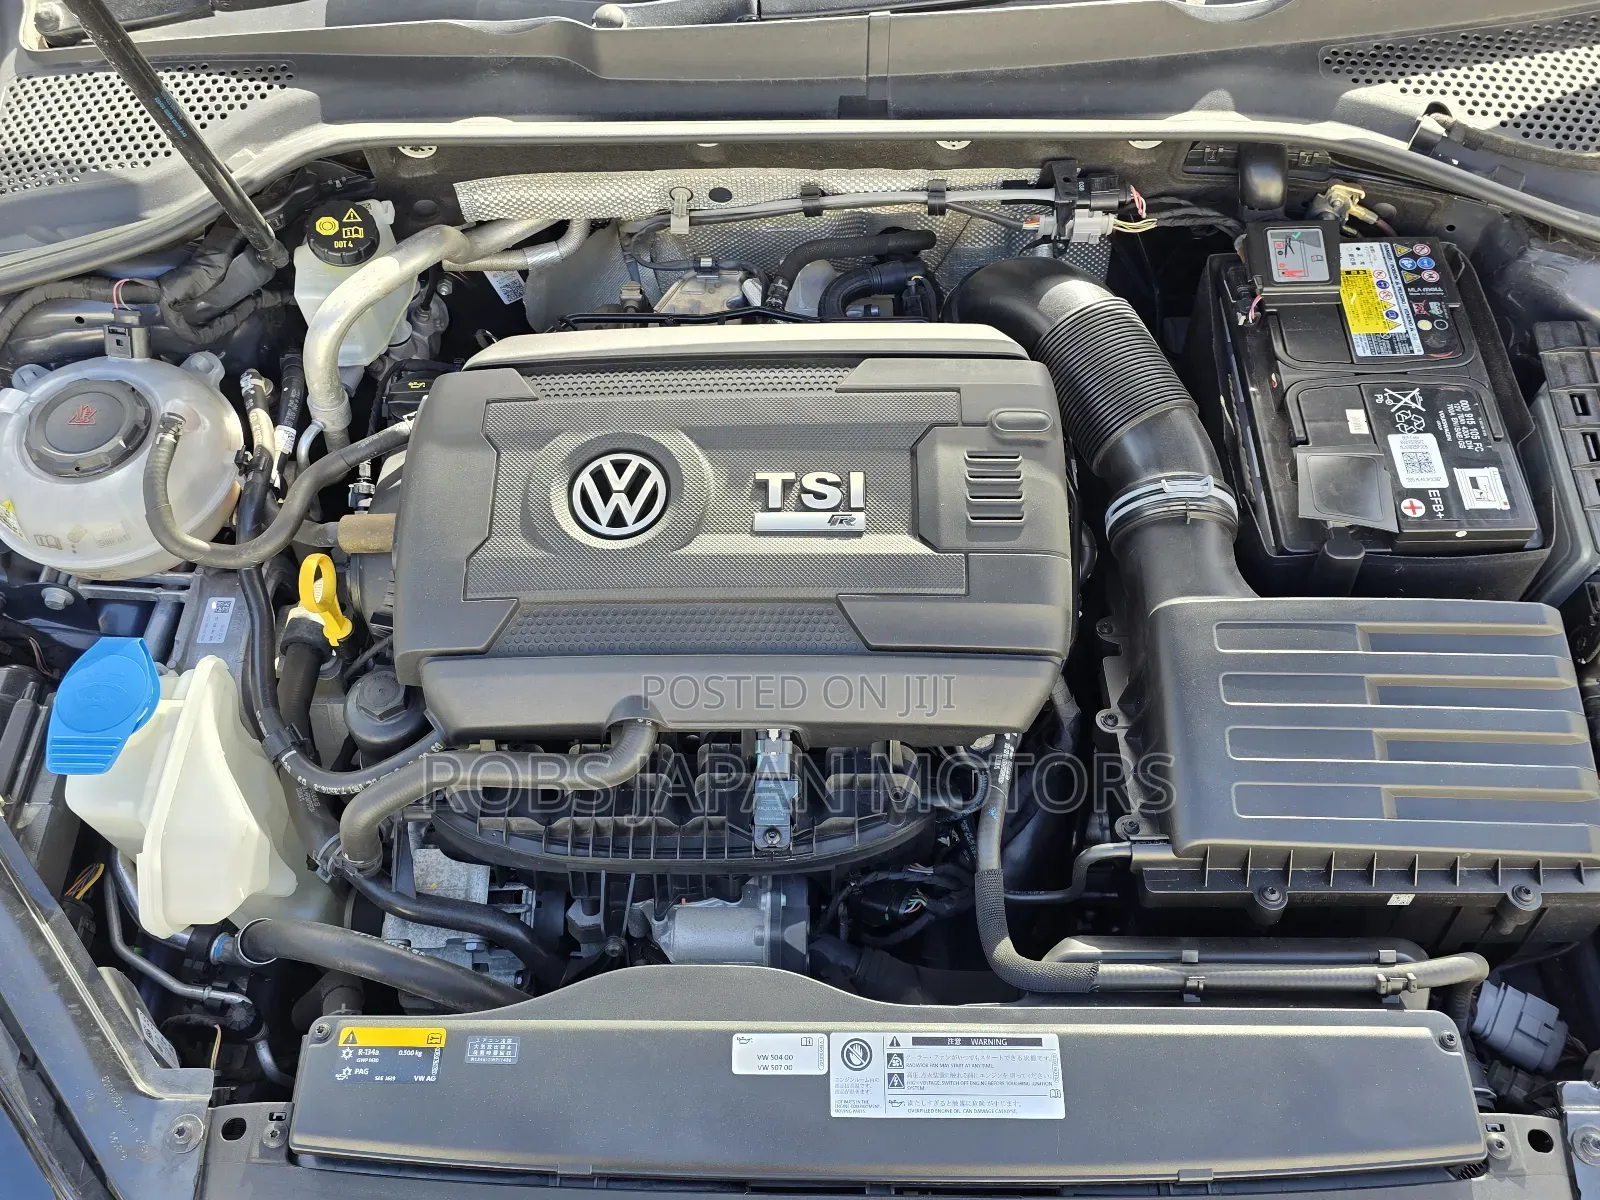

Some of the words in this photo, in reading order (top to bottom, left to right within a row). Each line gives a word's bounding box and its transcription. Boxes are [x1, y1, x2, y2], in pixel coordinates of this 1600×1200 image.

[334, 240, 347, 248] DOT
[348, 240, 353, 248] 4
[1374, 394, 1384, 404] Pb
[1446, 403, 1455, 416] 700A
[1454, 402, 1462, 412] 12V
[1460, 400, 1470, 412] 000
[1456, 413, 1466, 425] 70Ah
[1464, 413, 1474, 425] 915
[1438, 410, 1452, 441] VOLKSWAGEN
[1450, 417, 1466, 449] EN/SAE/GS
[1468, 427, 1479, 440] 105
[1464, 440, 1472, 450] DIN
[1473, 442, 1484, 452] FC
[755, 472, 866, 510] TSI
[1428, 490, 1444, 518] EFB+
[947, 1038, 961, 1046] 注意
[971, 1038, 1007, 1046] WARNING
